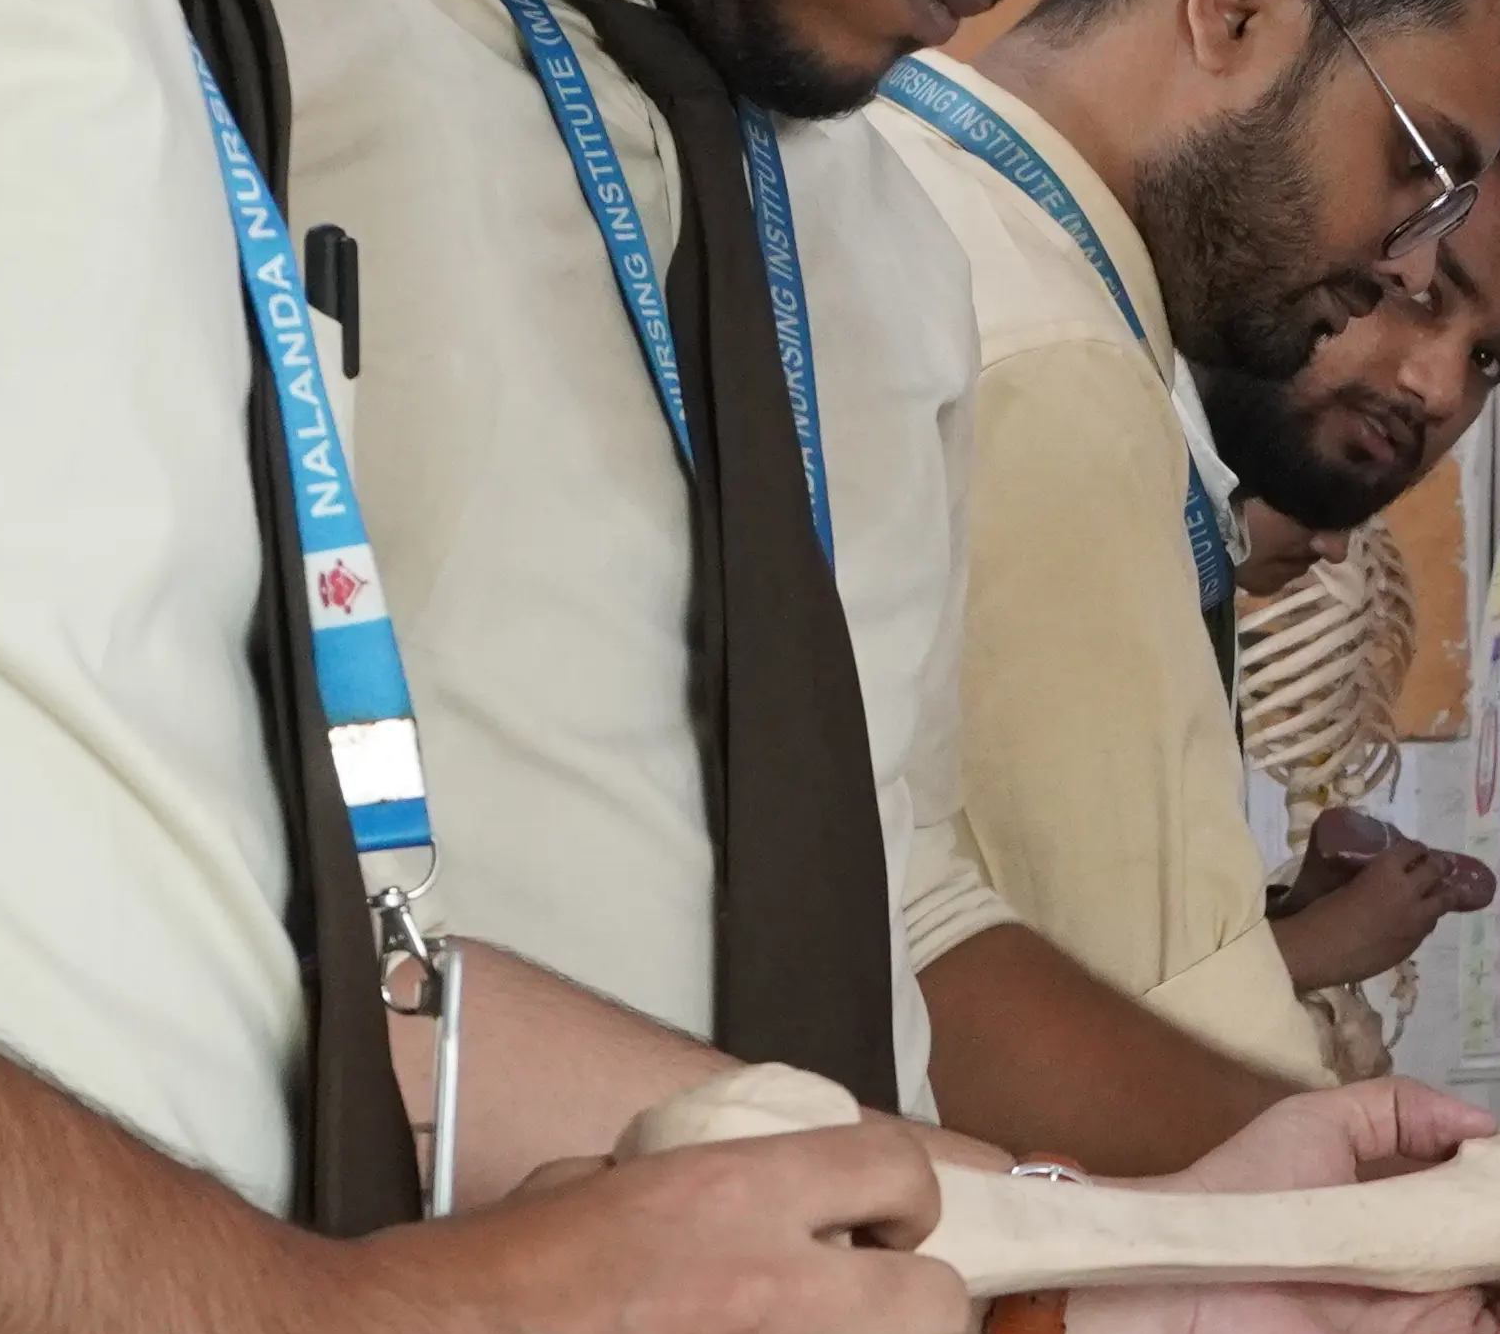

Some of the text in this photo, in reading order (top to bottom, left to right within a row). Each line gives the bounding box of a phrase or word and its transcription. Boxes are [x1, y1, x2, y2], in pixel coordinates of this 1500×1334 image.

[548, 56, 638, 242] INSTITUTE
[748, 123, 793, 282] INSTITUTE
[949, 100, 1066, 213] INSTITUTE
[257, 253, 346, 518] NALANDA
